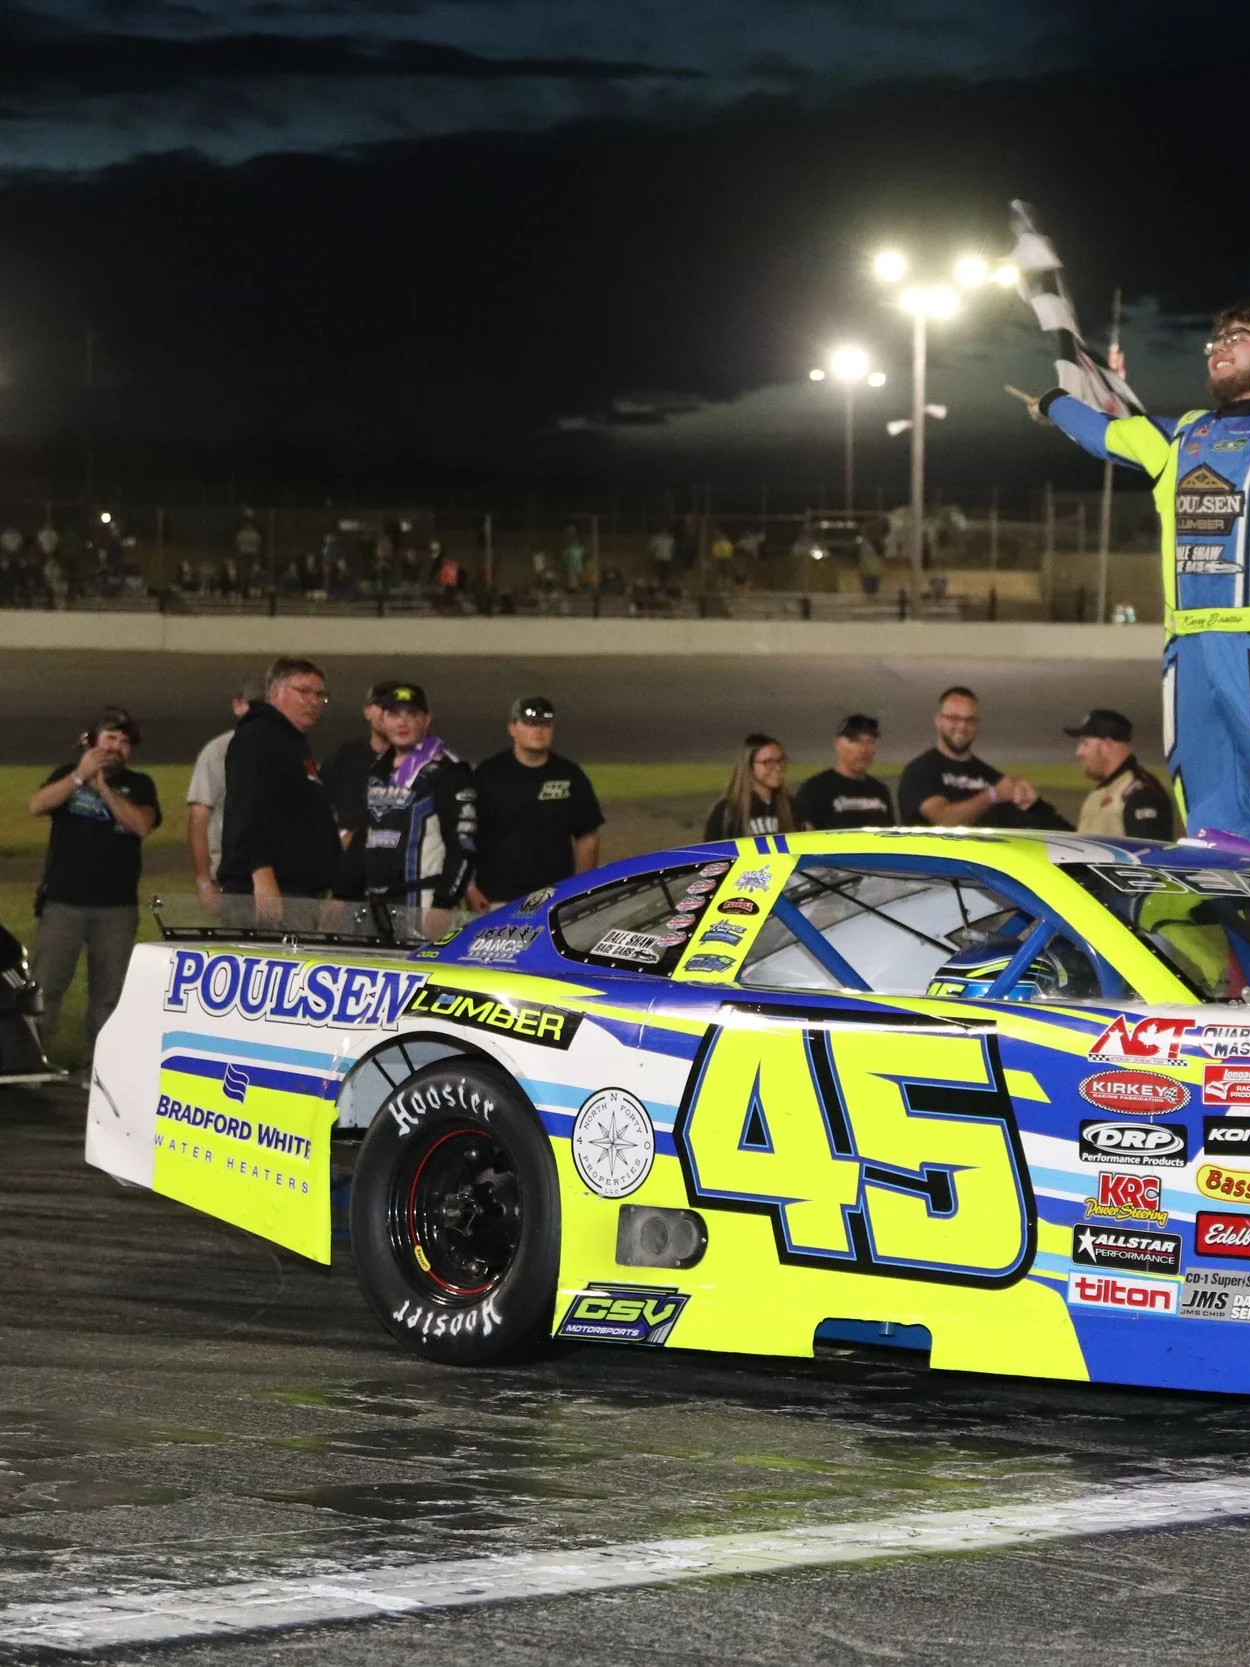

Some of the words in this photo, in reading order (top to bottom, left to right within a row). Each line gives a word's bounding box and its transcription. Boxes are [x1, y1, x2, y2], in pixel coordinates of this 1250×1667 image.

[1177, 495, 1242, 513] OULSEN
[603, 930, 630, 944] DALE
[626, 934, 658, 949] SHAW
[165, 949, 429, 1027] POULSEN
[411, 988, 566, 1041] LUMBER
[1089, 1015, 1196, 1059] ACT
[610, 1093, 618, 1101] N
[1092, 1081, 1168, 1097] KIRKEY
[388, 1077, 496, 1137] Hoosier
[584, 1102, 608, 1130] NORTH
[620, 1104, 643, 1134] FORTY
[156, 1094, 253, 1141] BRADFORD
[257, 1123, 312, 1160] WHITE
[1097, 1129, 1174, 1149] DRP
[679, 1008, 1032, 1282] 45
[1081, 1152, 1141, 1166] Performance
[1143, 1156, 1185, 1167] Products
[154, 1134, 212, 1163] WATER
[227, 1157, 309, 1194] HEATERS
[582, 1155, 641, 1186] PROPERTIES
[1099, 1172, 1161, 1210] KRC
[1086, 1198, 1119, 1219] Power
[1117, 1202, 1168, 1226] Steering
[1095, 1233, 1176, 1253] ALLSTAR
[1095, 1249, 1175, 1265] PERFORMANCE
[1186, 1272, 1209, 1285] CD-1
[1075, 1277, 1172, 1310] tilton
[1182, 1290, 1230, 1310] JMS
[392, 1288, 504, 1345] Hoosier
[573, 1297, 677, 1327] CSV
[1202, 1310, 1226, 1318] CHIP
[565, 1324, 640, 1337] MOTORSPORTS
